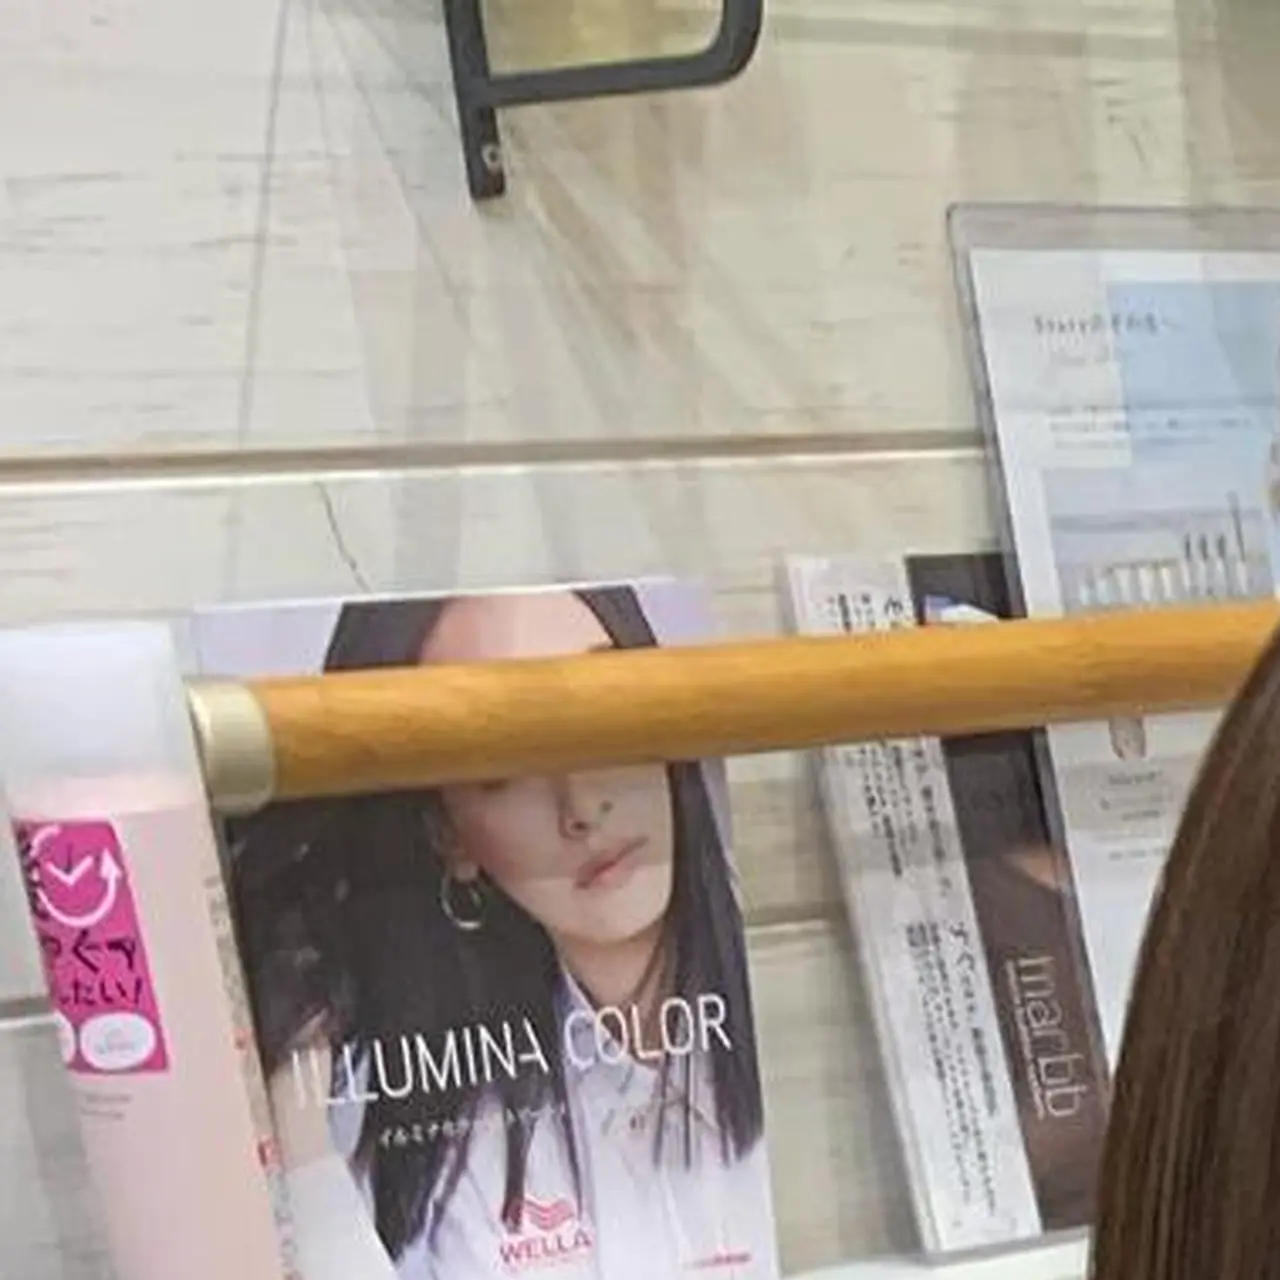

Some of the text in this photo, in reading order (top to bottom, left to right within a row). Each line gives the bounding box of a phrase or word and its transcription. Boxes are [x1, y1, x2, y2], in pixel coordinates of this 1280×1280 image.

[290, 993, 732, 1110] ILLUMINA COLOR
[1017, 955, 1090, 1118] marbb
[499, 1228, 592, 1264] WELLA
